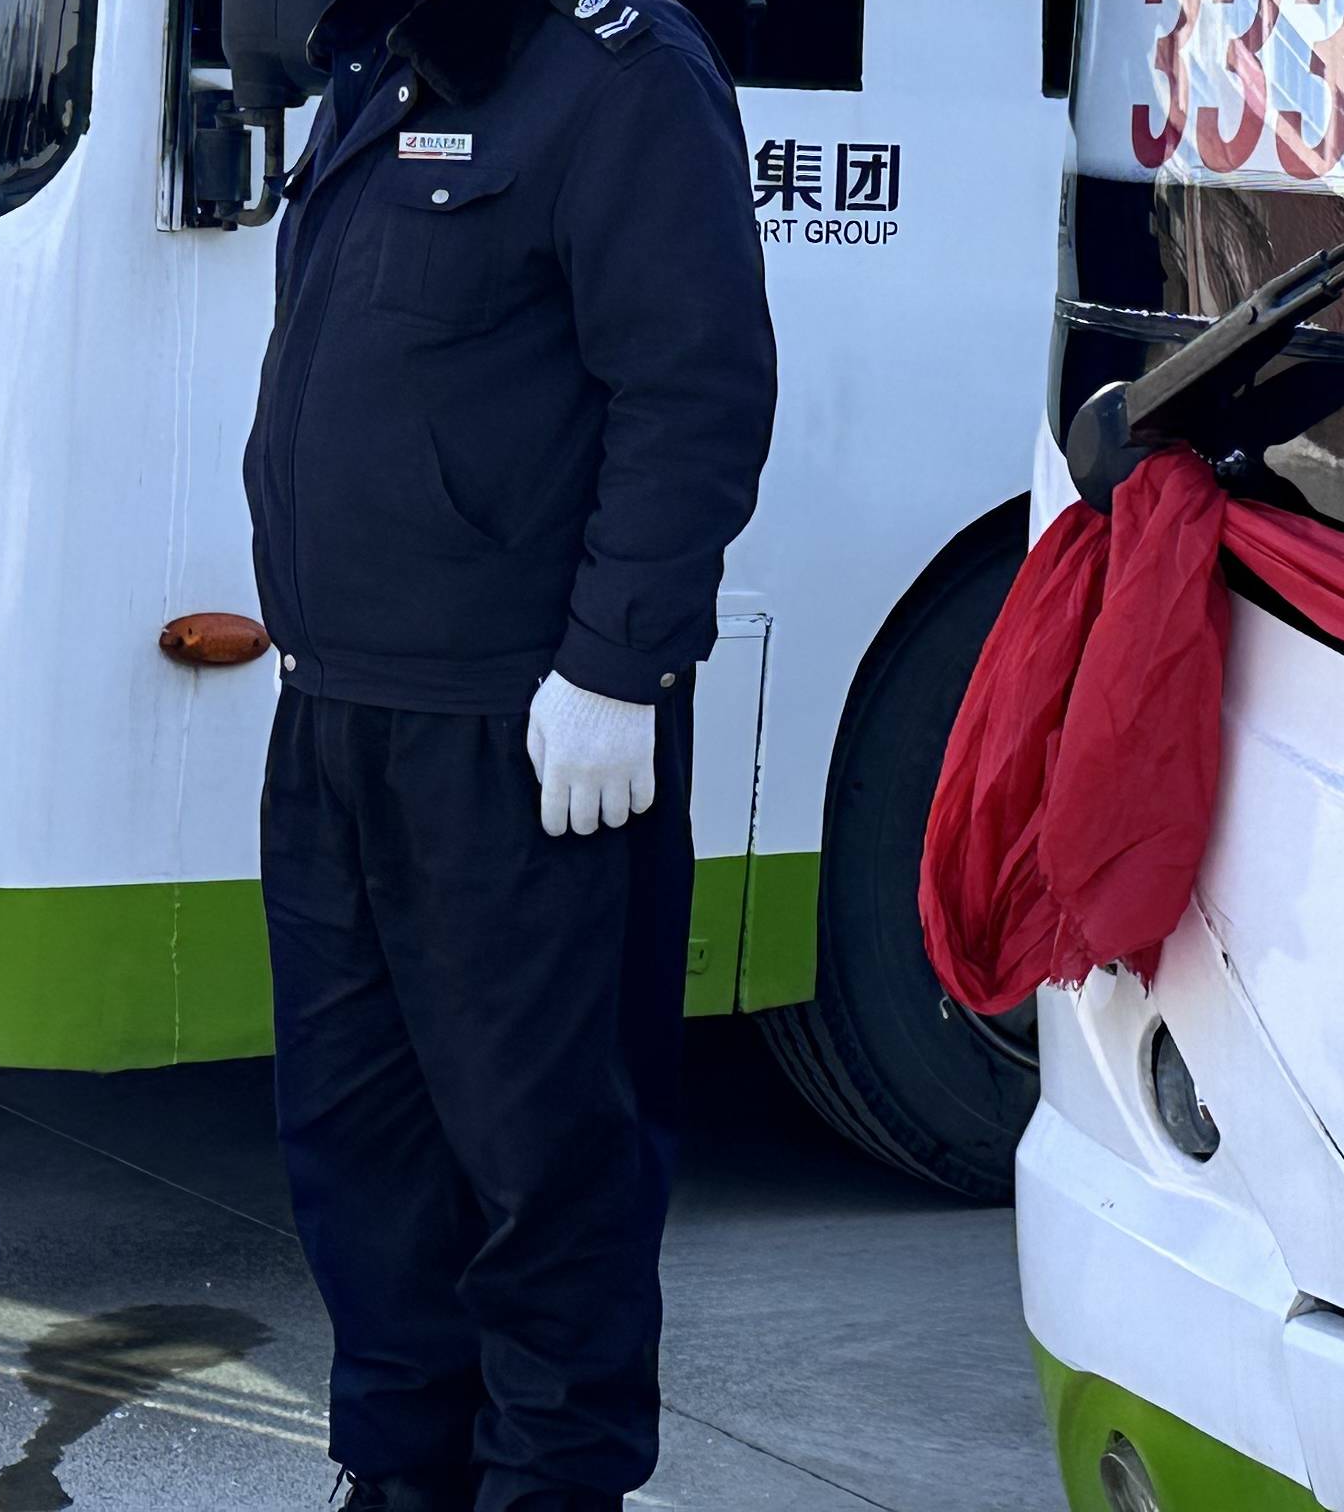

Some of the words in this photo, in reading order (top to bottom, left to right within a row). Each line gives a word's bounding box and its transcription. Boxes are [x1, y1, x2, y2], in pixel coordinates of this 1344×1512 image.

[753, 138, 901, 212] 集团
[755, 219, 798, 243] RT
[805, 219, 899, 245] GROUP
